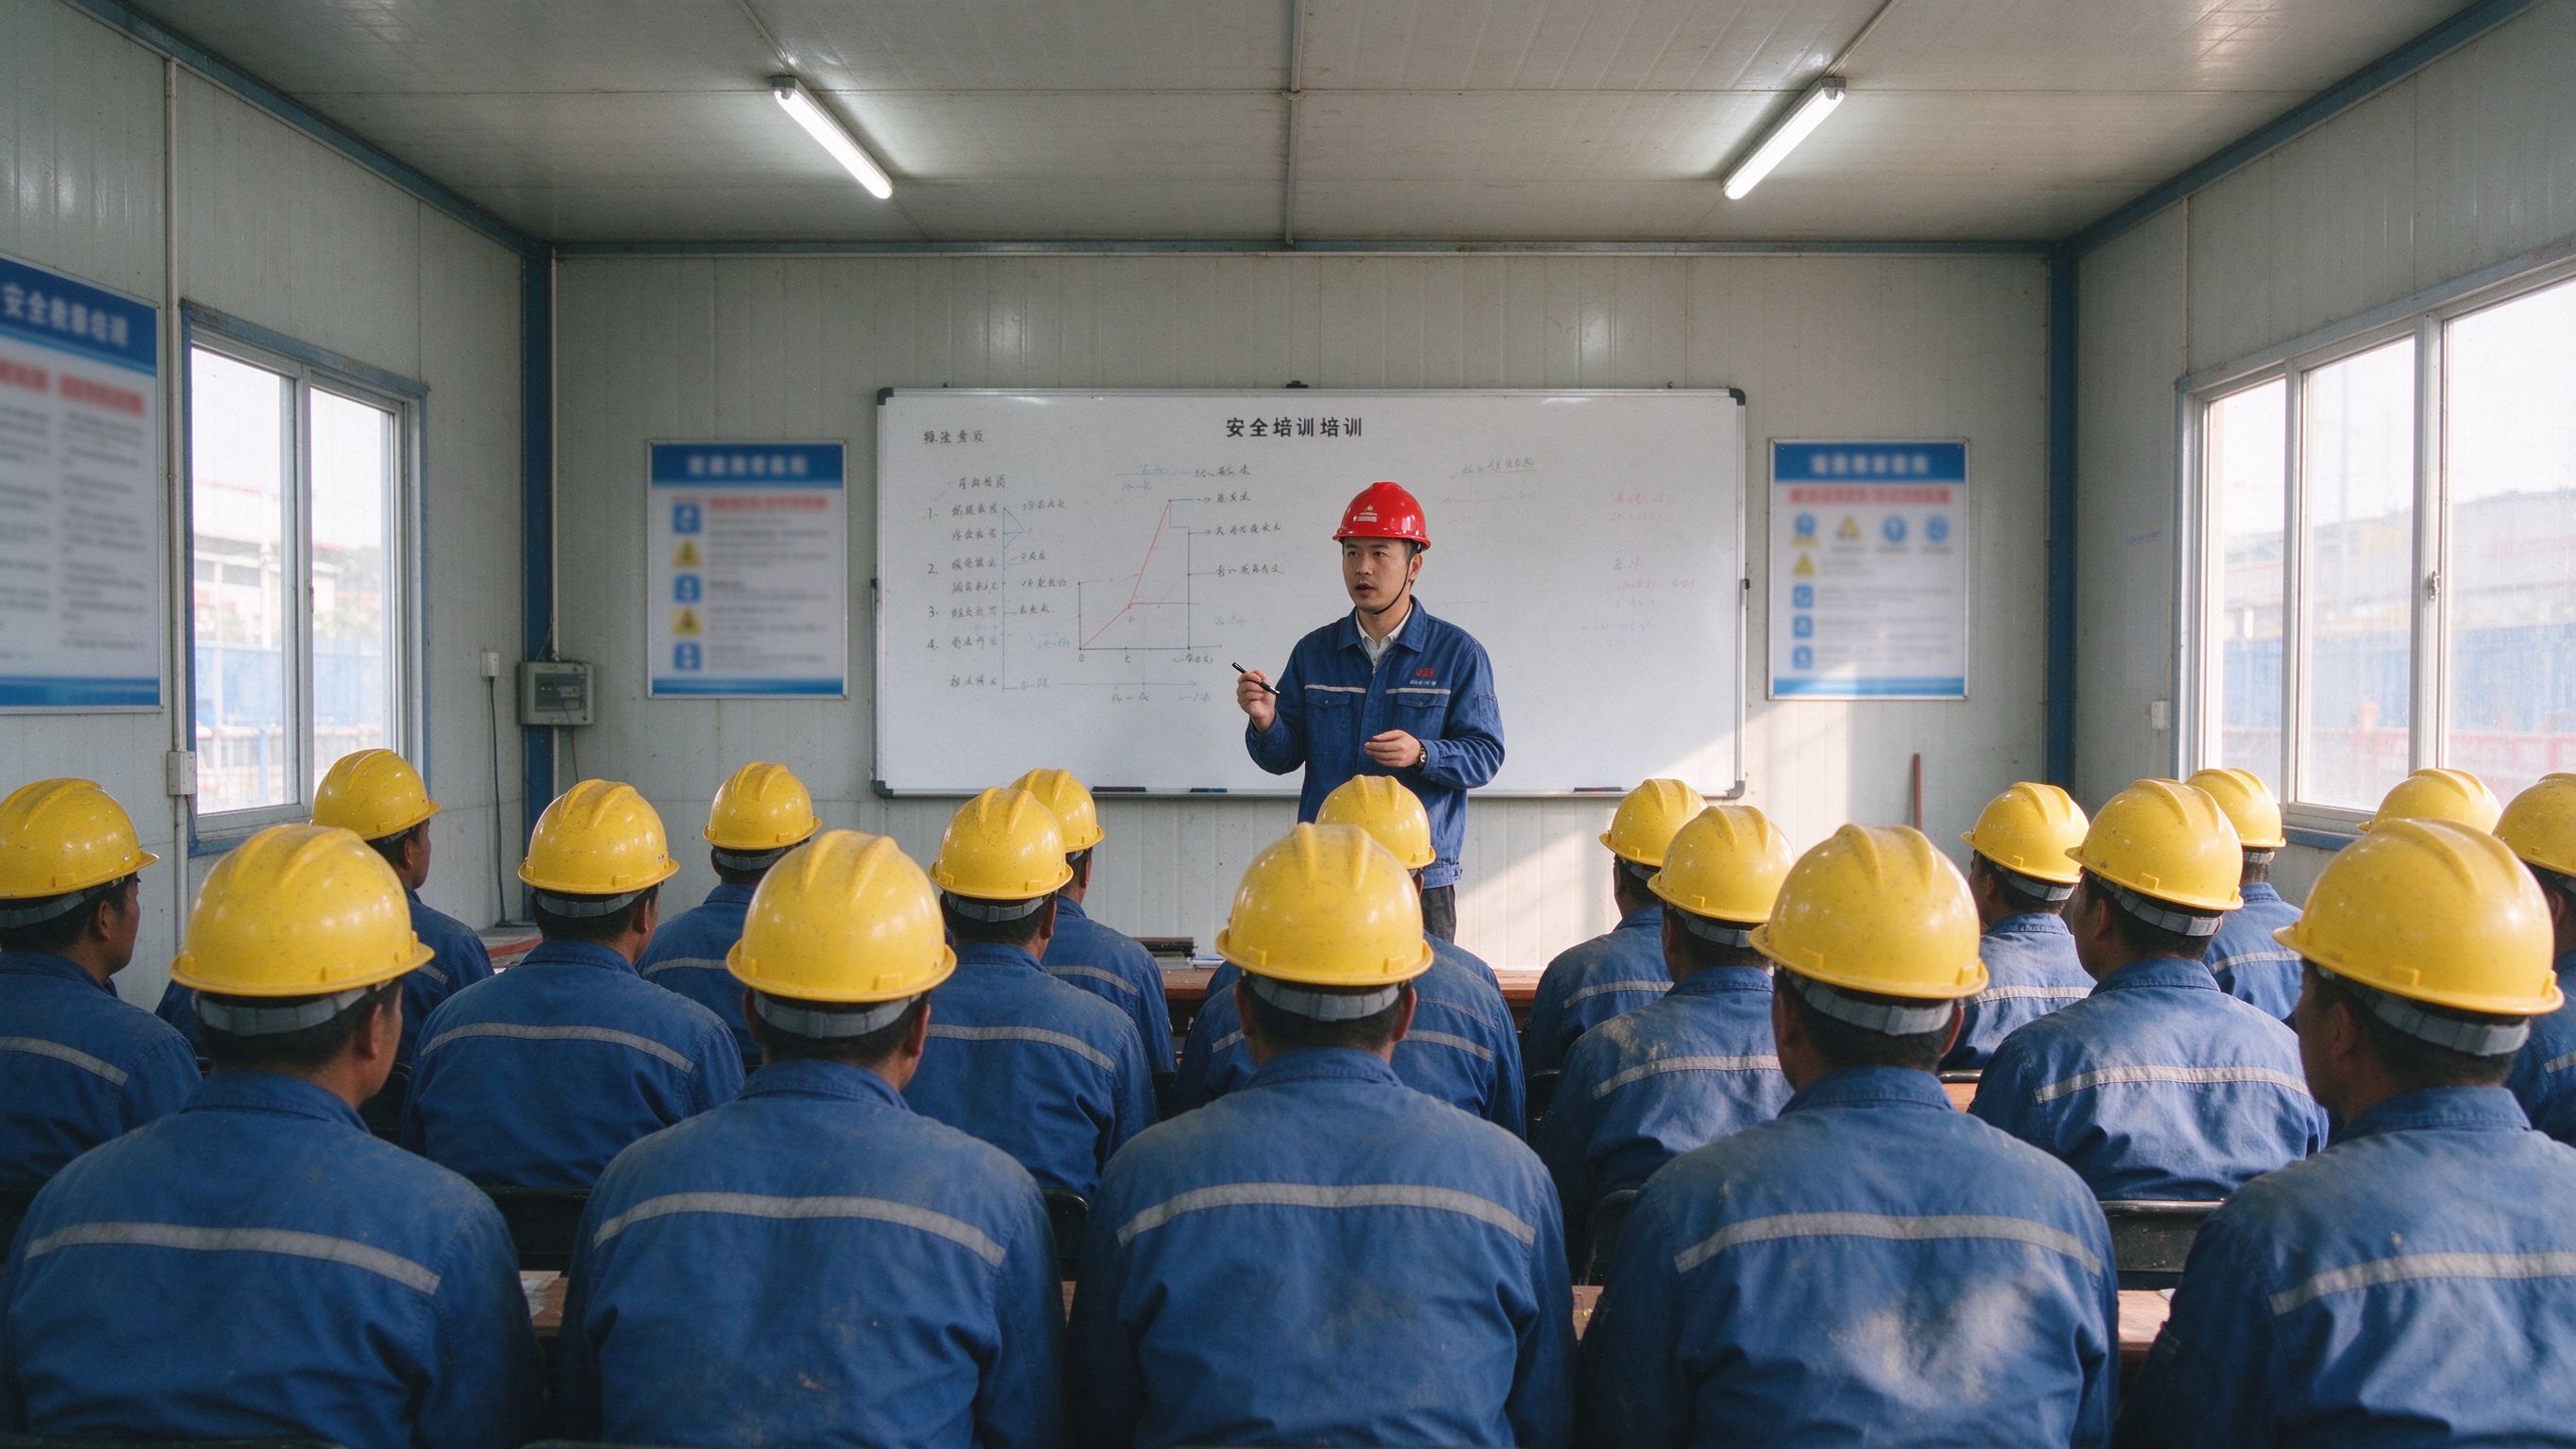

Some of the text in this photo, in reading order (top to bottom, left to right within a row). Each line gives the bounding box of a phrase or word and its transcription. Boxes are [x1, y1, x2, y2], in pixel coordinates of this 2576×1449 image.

[1226, 416, 1363, 438] 安全培训培训
[927, 562, 938, 575] 2.
[928, 606, 939, 618] 3.
[927, 639, 939, 650] 4.
